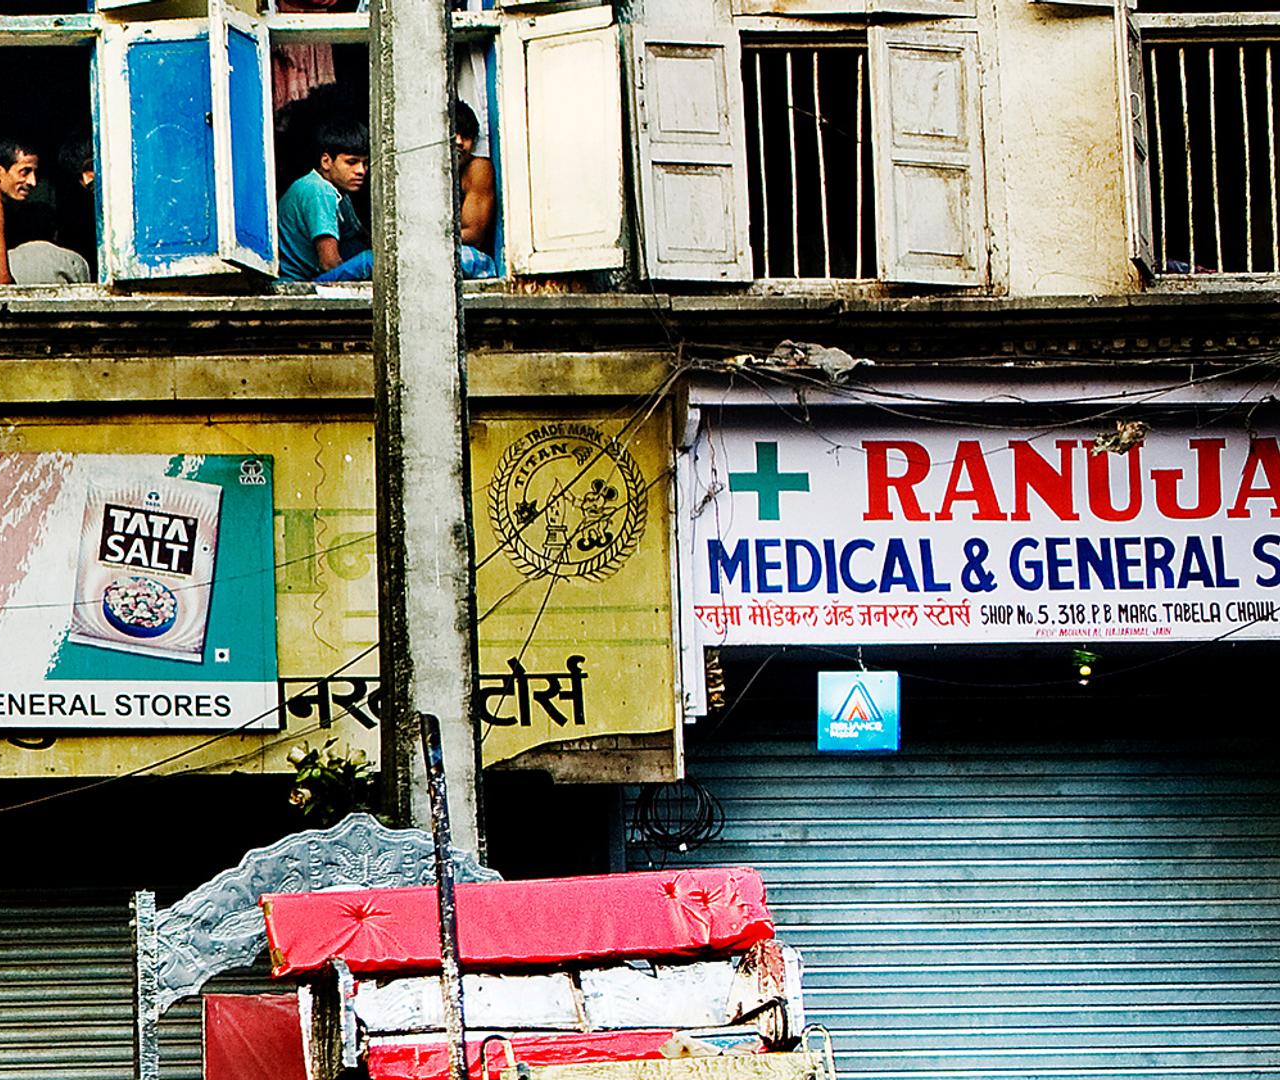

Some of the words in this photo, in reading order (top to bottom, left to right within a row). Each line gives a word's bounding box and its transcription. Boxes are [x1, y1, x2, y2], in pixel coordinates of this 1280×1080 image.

[240, 475, 266, 485] TATA
[515, 443, 568, 489] TITAN
[109, 509, 189, 543] TATA
[105, 534, 188, 572] SALT
[707, 537, 951, 593] MEDICAL
[960, 537, 997, 593] &
[1008, 535, 1240, 592] GENERAL
[857, 605, 918, 628] जनरल
[924, 598, 972, 627] स्टोर्स
[980, 604, 1014, 625] SHOP
[1162, 602, 1222, 623] TABELA
[115, 694, 231, 718] STORES
